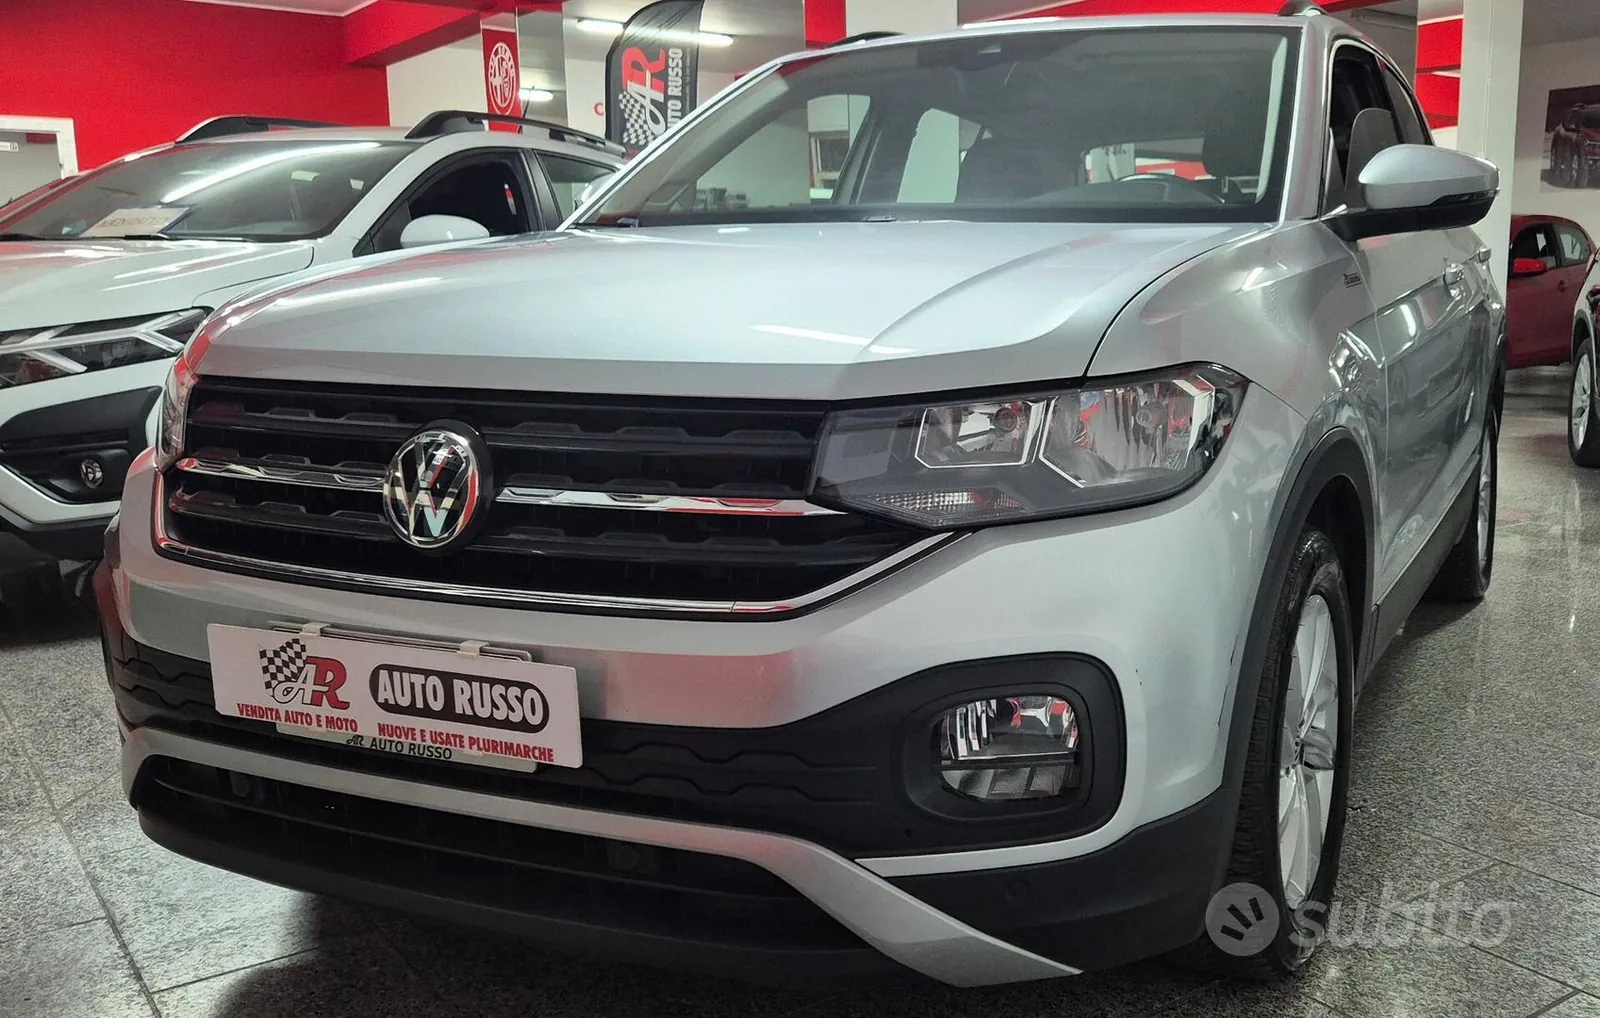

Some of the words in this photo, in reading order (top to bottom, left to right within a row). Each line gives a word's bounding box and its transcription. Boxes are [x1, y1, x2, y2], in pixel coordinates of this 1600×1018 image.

[667, 48, 683, 97] RUSSO
[667, 99, 683, 130] UTO
[273, 655, 350, 711] AR
[377, 669, 445, 712] AUTO
[453, 678, 544, 726] RUSSO
[237, 702, 282, 722] VENDITA
[284, 710, 313, 726] AUTO
[316, 715, 322, 728] E
[325, 716, 359, 733] MOTO
[370, 737, 404, 753] AUTO
[408, 740, 453, 760] RUSSO
[377, 722, 417, 742] NUOVE
[420, 728, 427, 743] E
[430, 730, 465, 749] USATE
[468, 735, 554, 762] PLURIMARCHE
